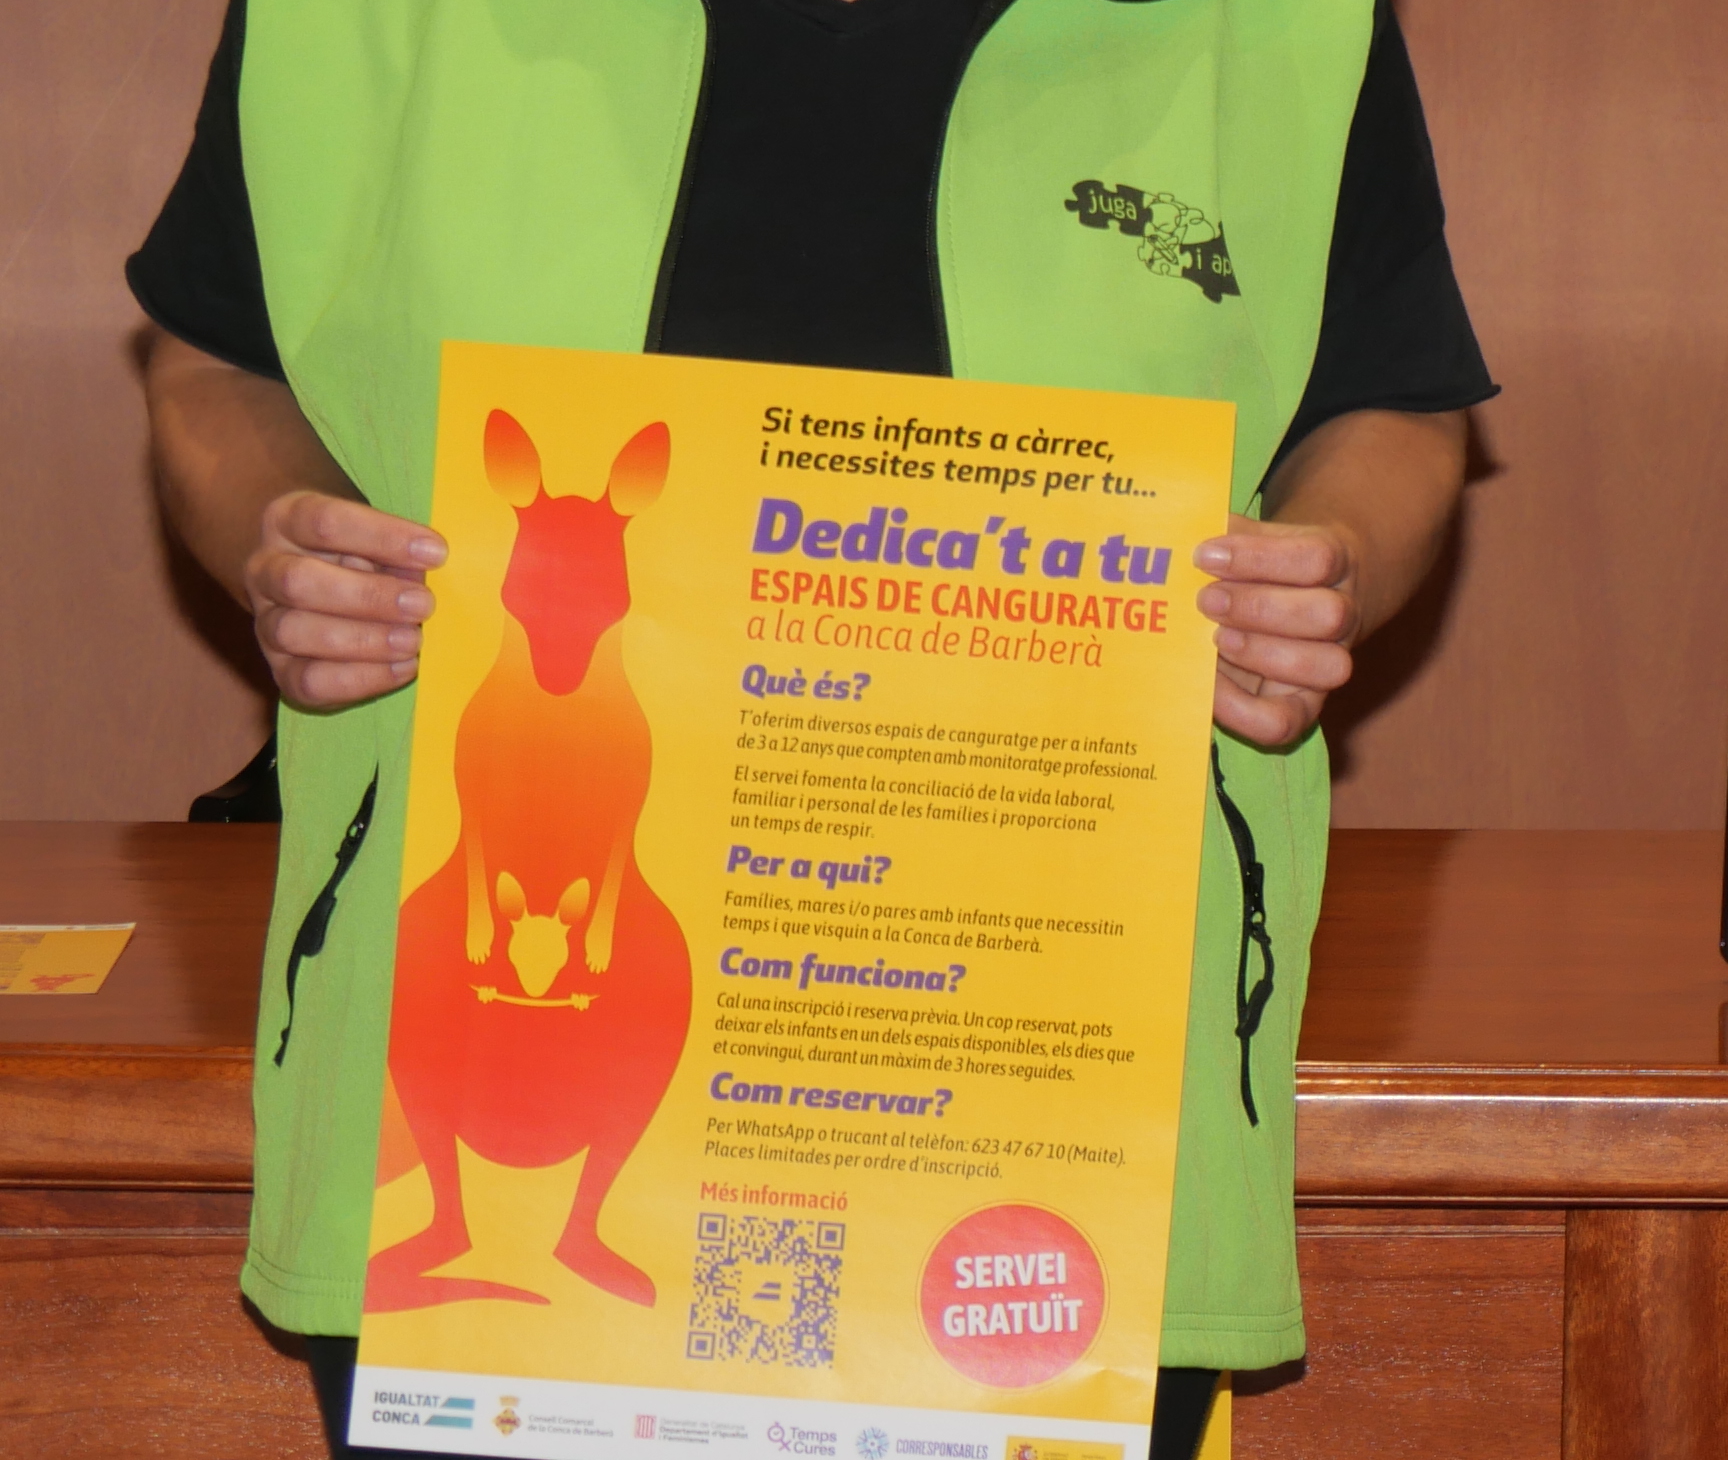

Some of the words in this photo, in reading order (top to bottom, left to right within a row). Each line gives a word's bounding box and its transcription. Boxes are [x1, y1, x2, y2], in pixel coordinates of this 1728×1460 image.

[1088, 190, 1137, 220] juga
[752, 498, 1031, 574] Dedica't
[1042, 539, 1085, 578] a
[1099, 535, 1171, 584] tu
[751, 568, 867, 609] ESPAIS
[877, 579, 922, 614] DE
[932, 583, 1168, 633] CANGURATGE
[720, 947, 793, 979] Com
[799, 953, 966, 992] funciona?
[710, 1072, 783, 1104] Com
[789, 1087, 953, 1117] reservar?
[956, 1252, 1066, 1288] SERVEI
[944, 1293, 1083, 1337] GRATUÏT
